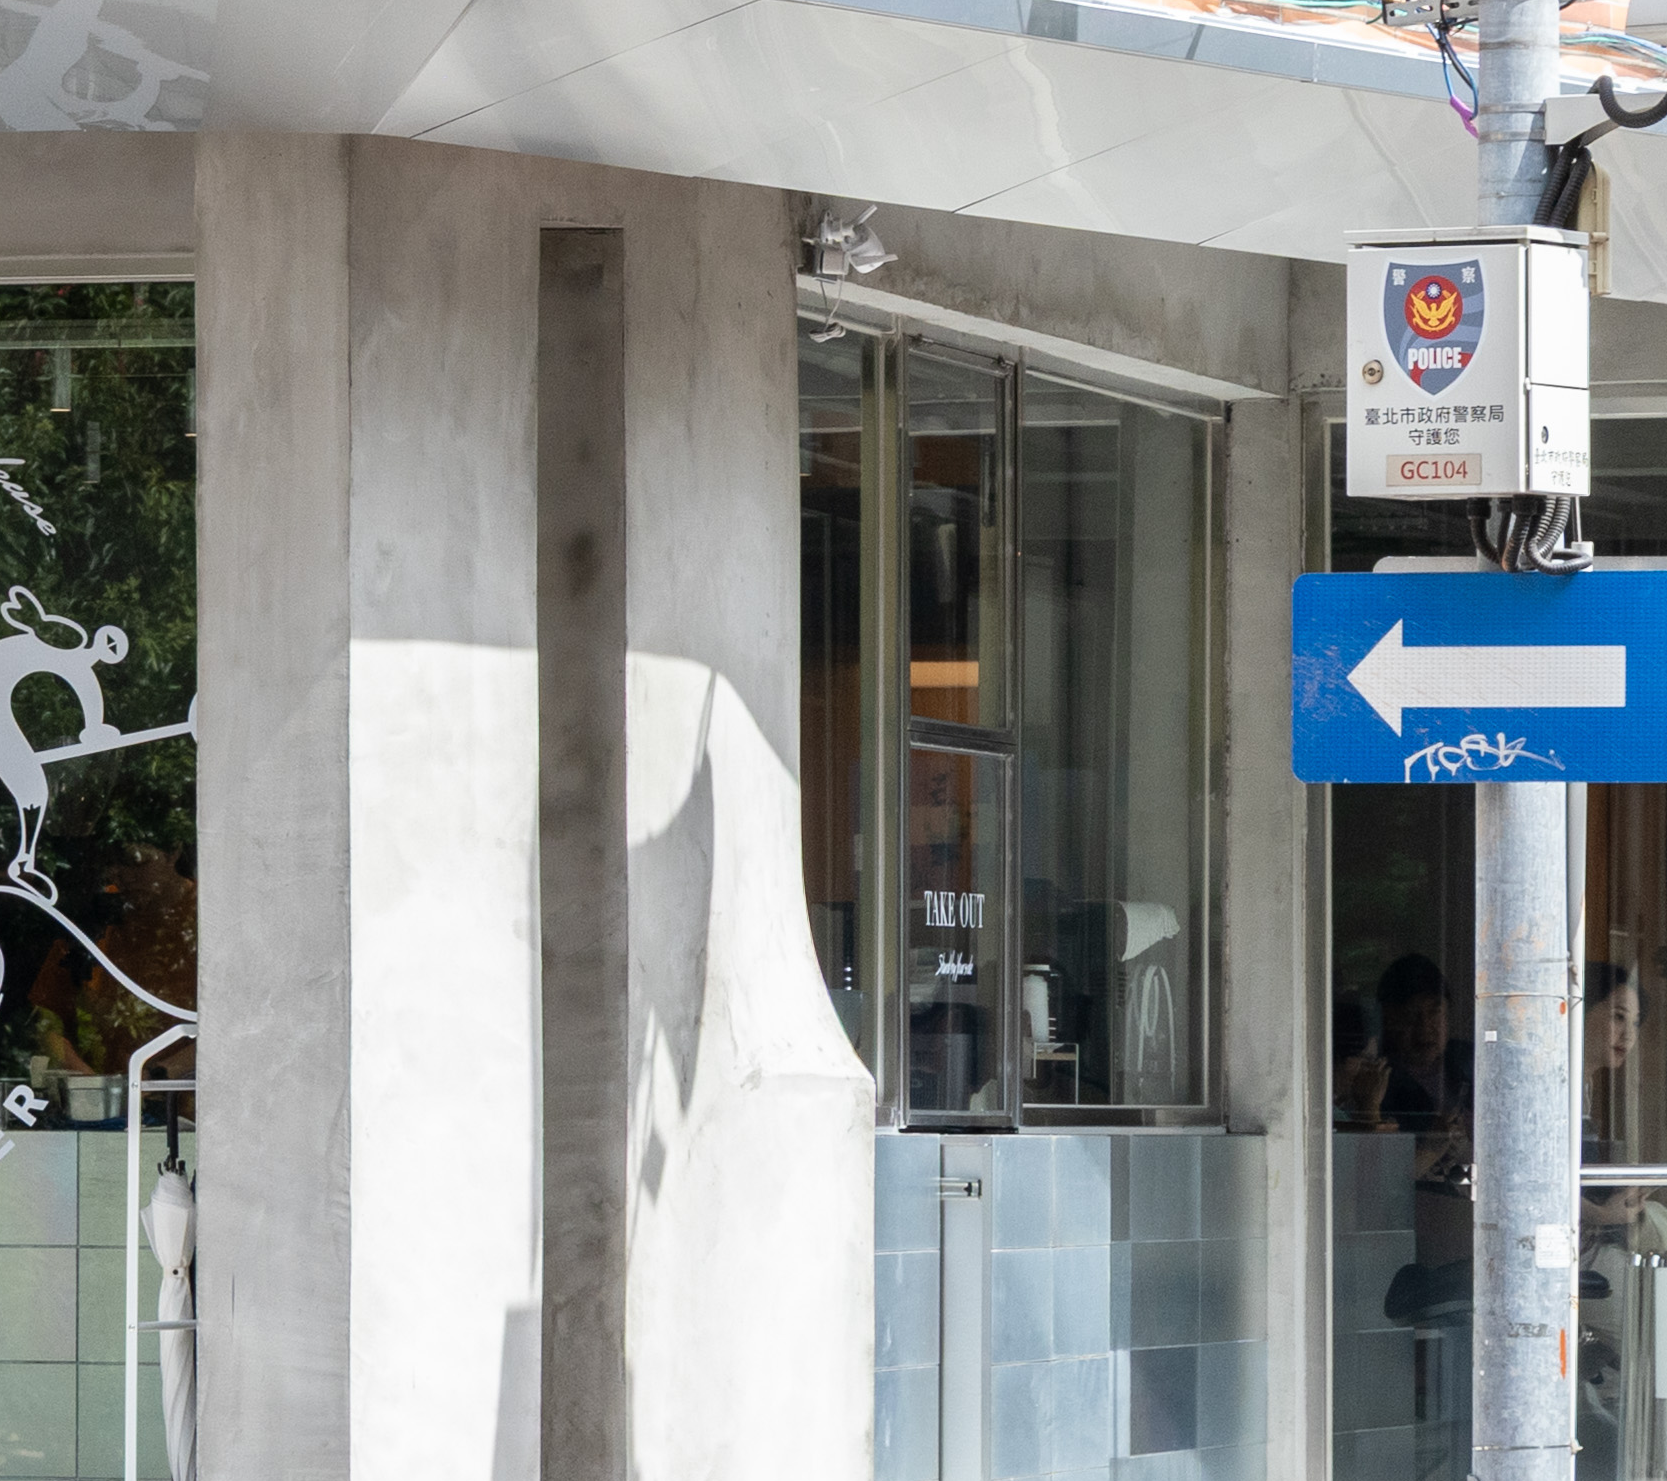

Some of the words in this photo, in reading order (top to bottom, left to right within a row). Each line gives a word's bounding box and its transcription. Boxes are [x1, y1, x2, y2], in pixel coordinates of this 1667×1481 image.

[1407, 346, 1463, 370] POLICE
[1364, 404, 1505, 426] 臺北市政府警察局
[1408, 427, 1461, 446] 守護您
[1399, 459, 1469, 480] GC104
[923, 890, 956, 927] TAKE
[959, 892, 986, 929] OUT
